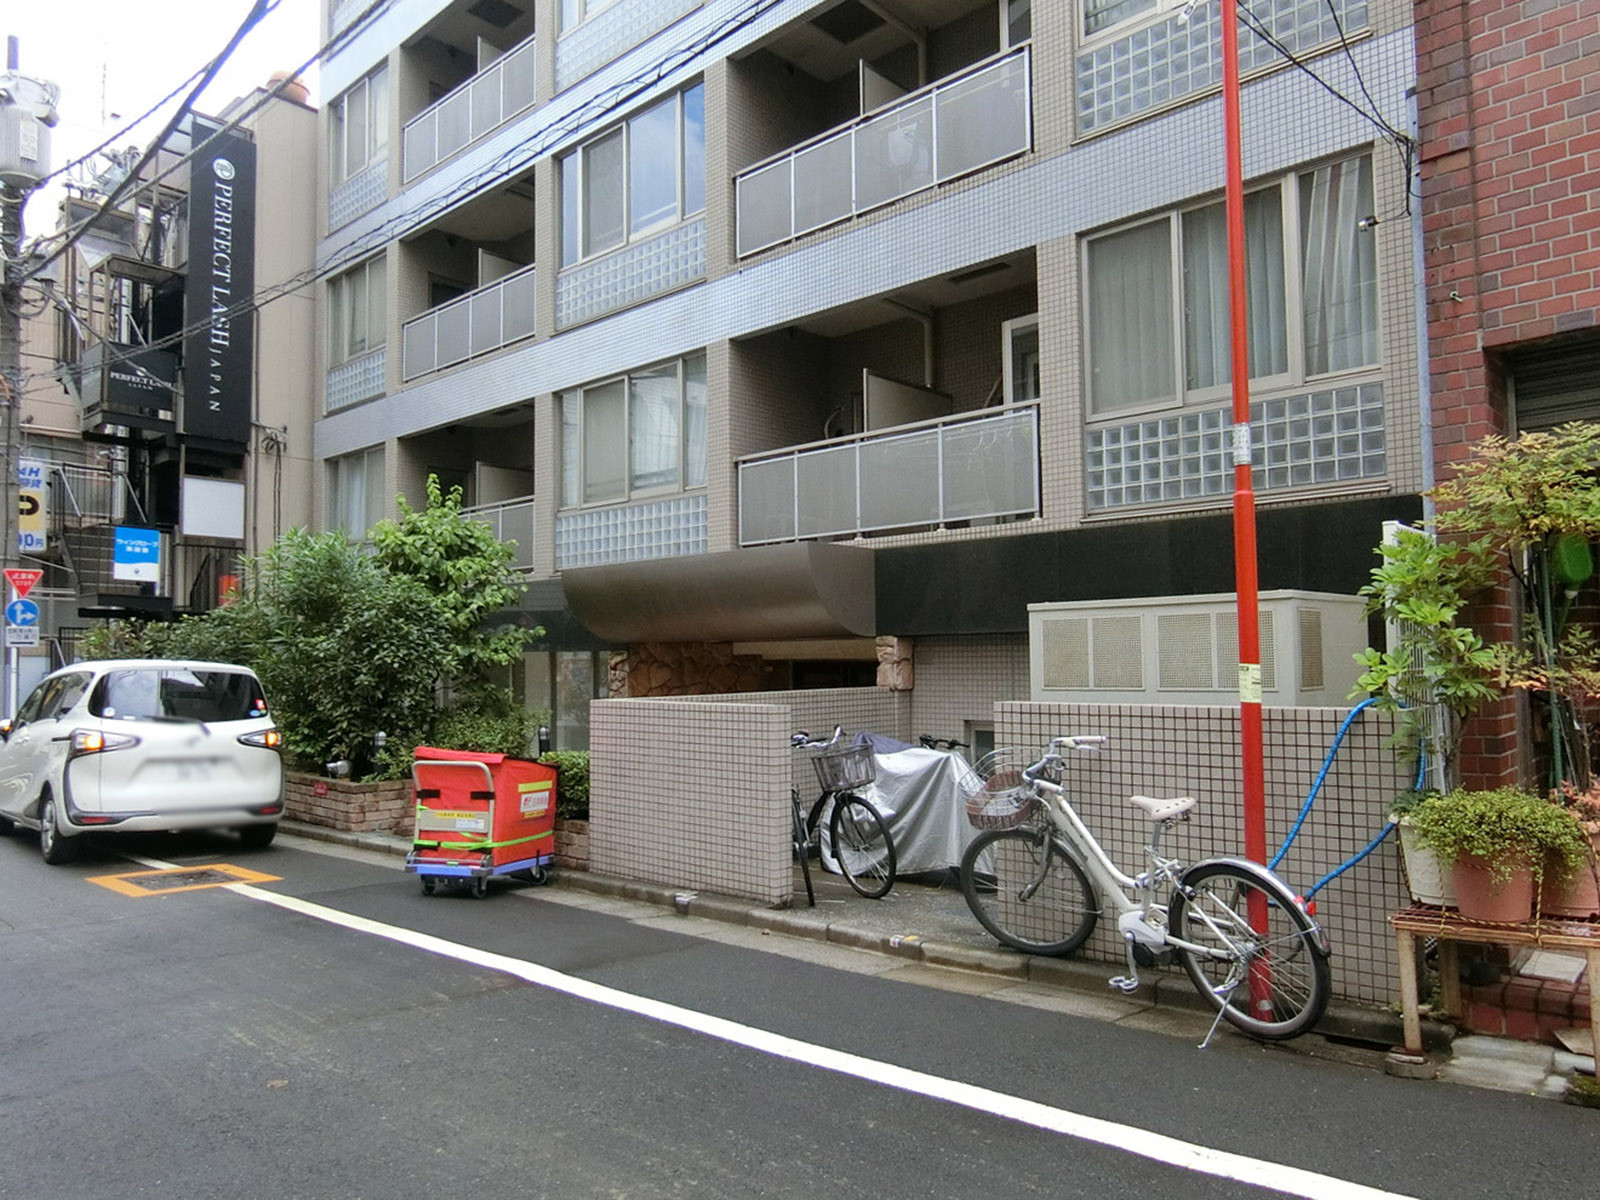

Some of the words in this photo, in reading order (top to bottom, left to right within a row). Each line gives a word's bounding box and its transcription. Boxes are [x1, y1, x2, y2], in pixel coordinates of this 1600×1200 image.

[213, 181, 233, 283] PERFECT
[211, 285, 230, 347] LASH
[208, 347, 222, 411] JAPAN
